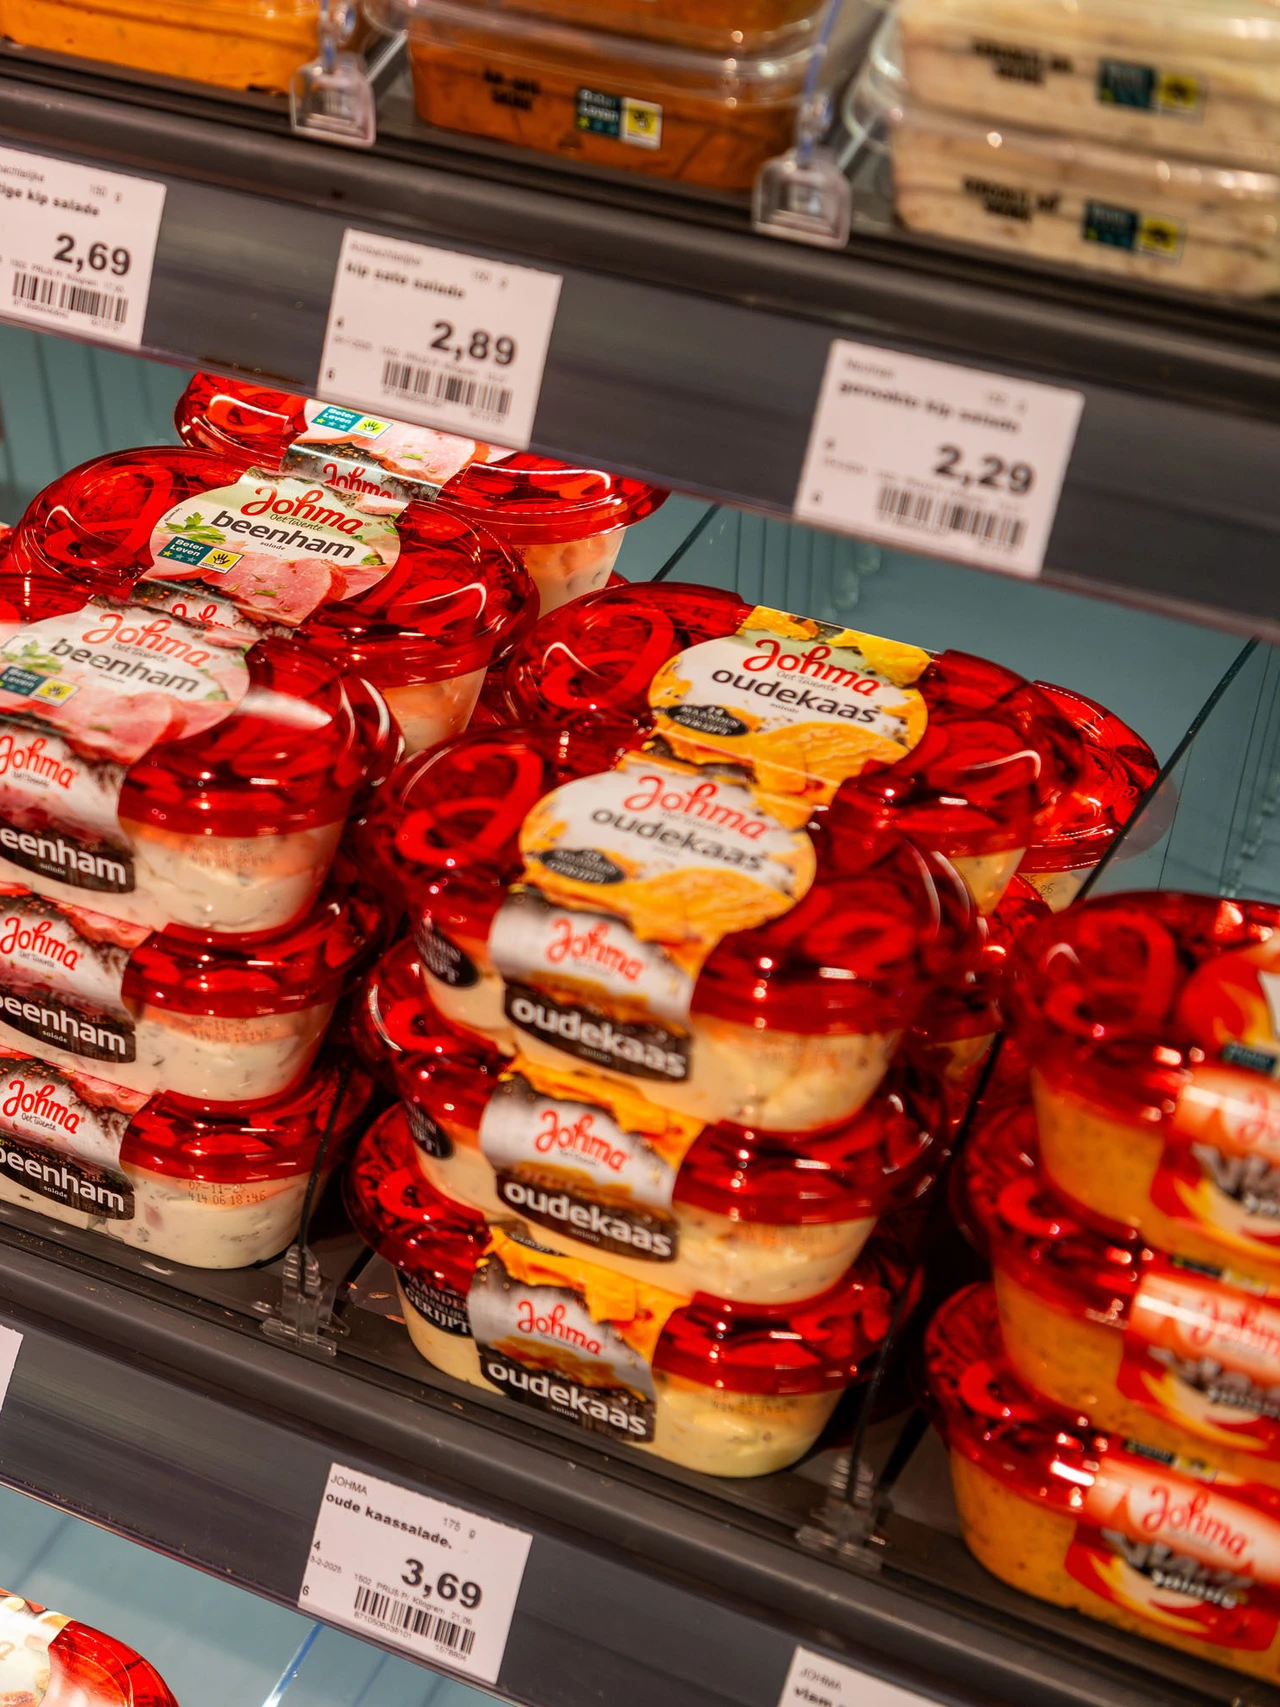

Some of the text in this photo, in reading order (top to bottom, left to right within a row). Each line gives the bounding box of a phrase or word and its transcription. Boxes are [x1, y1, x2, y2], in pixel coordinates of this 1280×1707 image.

[28, 188, 49, 206] kip
[52, 198, 100, 217] salade
[54, 233, 132, 276] 2,69
[430, 320, 517, 366] 2,89
[323, 412, 352, 425] Leven
[328, 406, 356, 420] Beter
[933, 443, 1036, 496] 2,29
[211, 511, 356, 558] beenham
[254, 486, 367, 535] Johma
[270, 514, 324, 530] Oet Twente
[170, 544, 200, 557] Leven
[175, 539, 204, 551] Beter
[82, 613, 212, 668] Johma
[48, 638, 202, 695] beenham
[742, 638, 882, 697] Johma
[712, 668, 882, 726] oudekaas
[622, 774, 770, 842] Johma
[590, 807, 766, 872] oudekaas
[0, 916, 84, 972] Johma
[546, 916, 646, 984] Johma
[512, 995, 686, 1080] oudekaas
[2, 1079, 86, 1135] Johma
[536, 1110, 630, 1172] Johma
[43, 1186, 69, 1200] salade
[188, 1190, 266, 1205] 414 18:46
[504, 1181, 672, 1258] oudekaas
[405, 1287, 468, 1334] GERIJPT
[516, 1300, 604, 1358] Johma
[488, 1362, 648, 1436] oudekaas
[330, 1474, 368, 1496] JOHMA
[313, 1540, 322, 1551] 4
[326, 1492, 452, 1550] oude kaassalade.
[442, 1516, 462, 1532] 175
[1142, 1485, 1247, 1557] Johma
[302, 1586, 310, 1596] 6
[400, 1557, 484, 1612] 3,69
[412, 1596, 445, 1614] Kilogram
[800, 1668, 842, 1692] JOHMA
